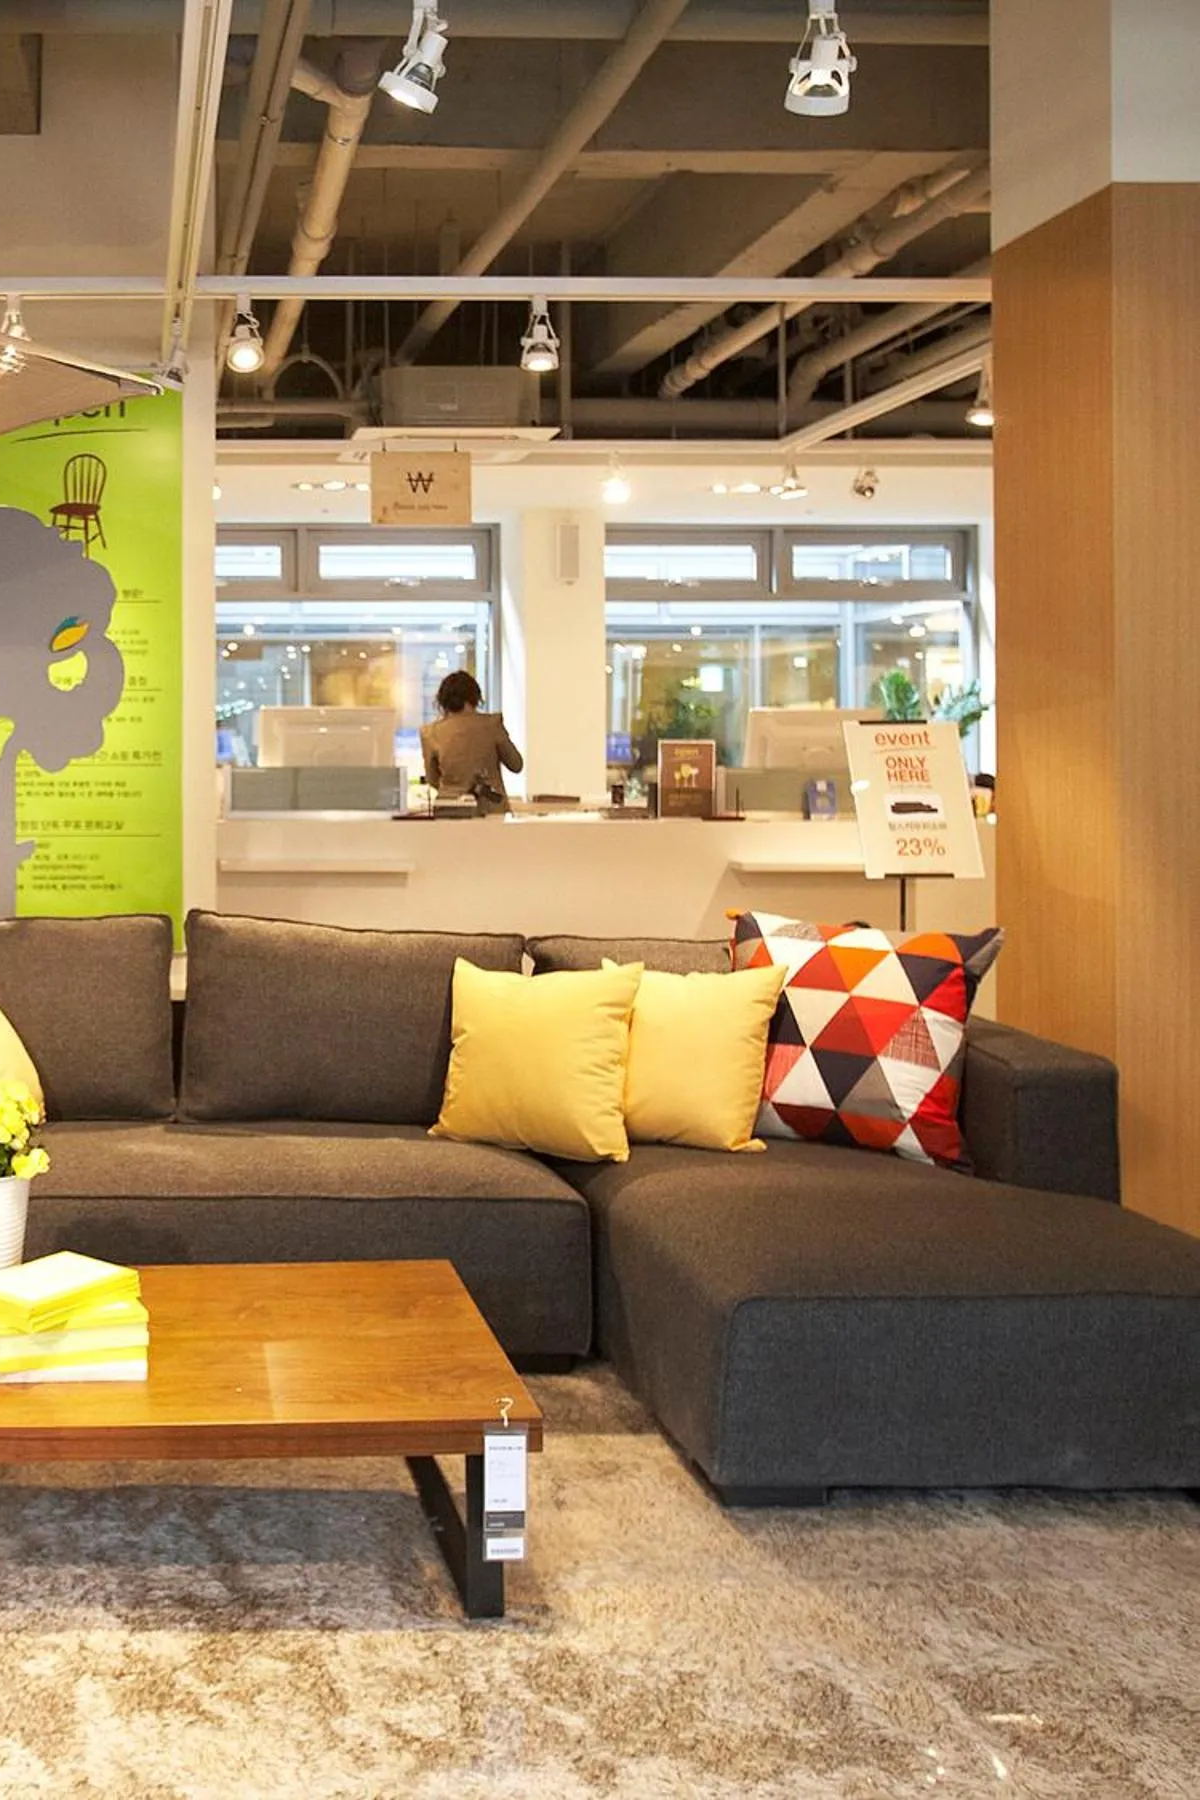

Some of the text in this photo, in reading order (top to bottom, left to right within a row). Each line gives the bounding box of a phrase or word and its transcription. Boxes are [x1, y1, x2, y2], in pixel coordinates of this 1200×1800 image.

[874, 730, 931, 747] event
[885, 756, 927, 769] ONLY
[887, 769, 930, 783] HERE
[896, 837, 946, 857] 23%
